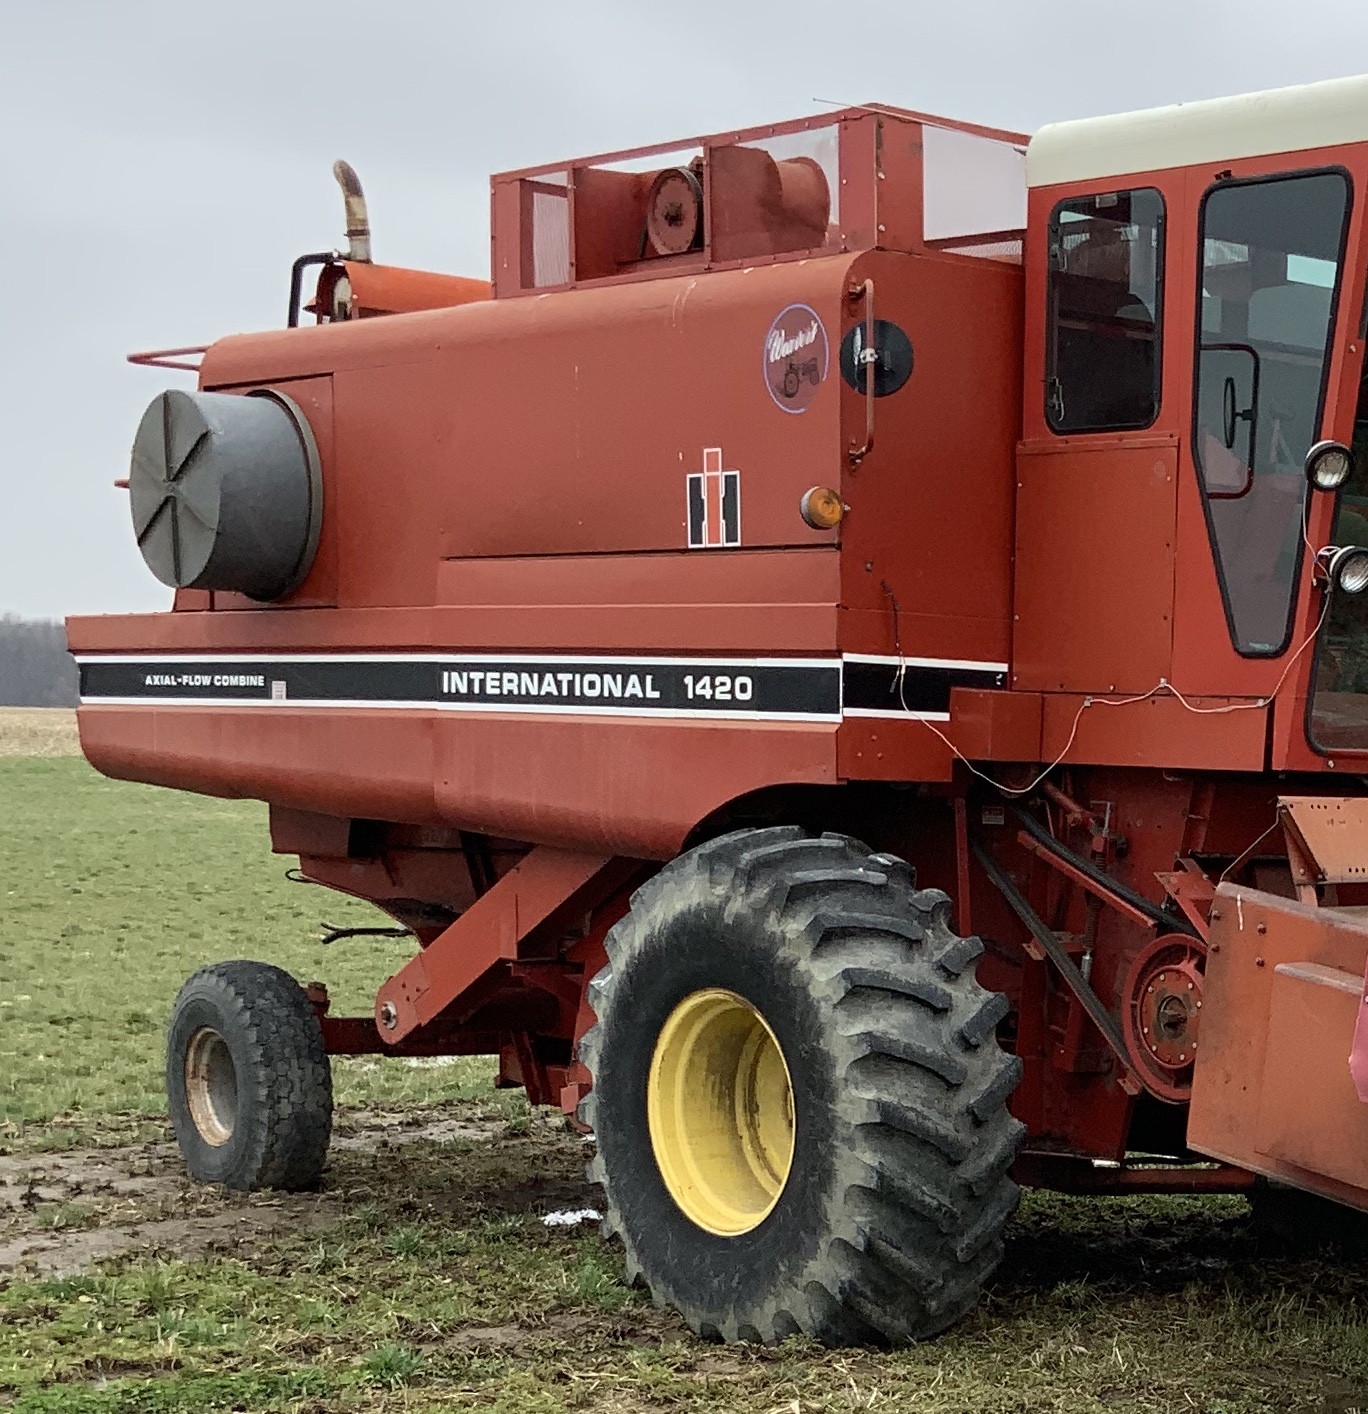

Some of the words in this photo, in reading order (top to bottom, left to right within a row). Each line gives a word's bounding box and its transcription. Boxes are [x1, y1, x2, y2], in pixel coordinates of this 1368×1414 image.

[145, 675, 211, 686] AXIAL-FLOW
[213, 675, 265, 687] COMBINE
[442, 671, 660, 699] INTERNATIONAL
[683, 675, 753, 700] 1420
